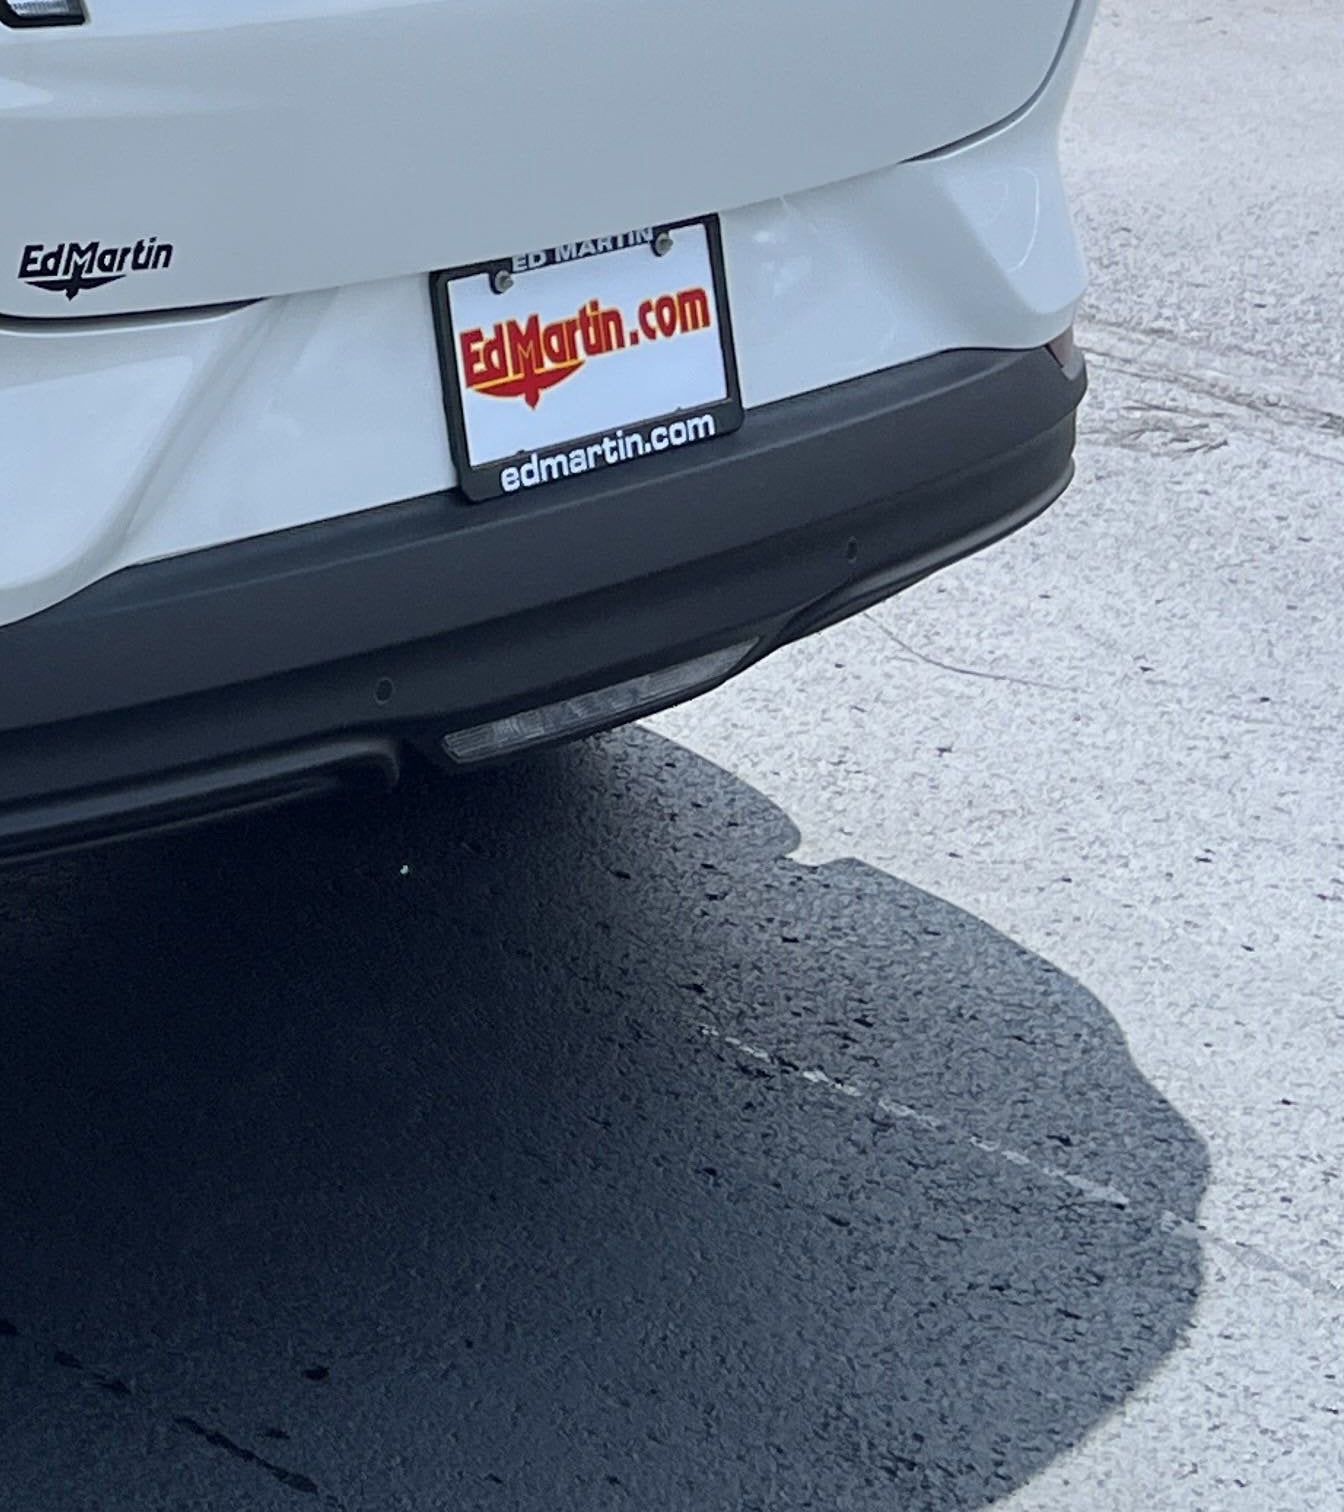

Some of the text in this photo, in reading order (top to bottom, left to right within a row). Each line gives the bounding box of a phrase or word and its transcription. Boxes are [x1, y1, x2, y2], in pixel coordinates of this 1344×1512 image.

[18, 237, 173, 280] EdMartin
[512, 227, 655, 273] ED MARTIN
[459, 287, 712, 390] EdMartin.com
[500, 413, 716, 492] edmartin.com
